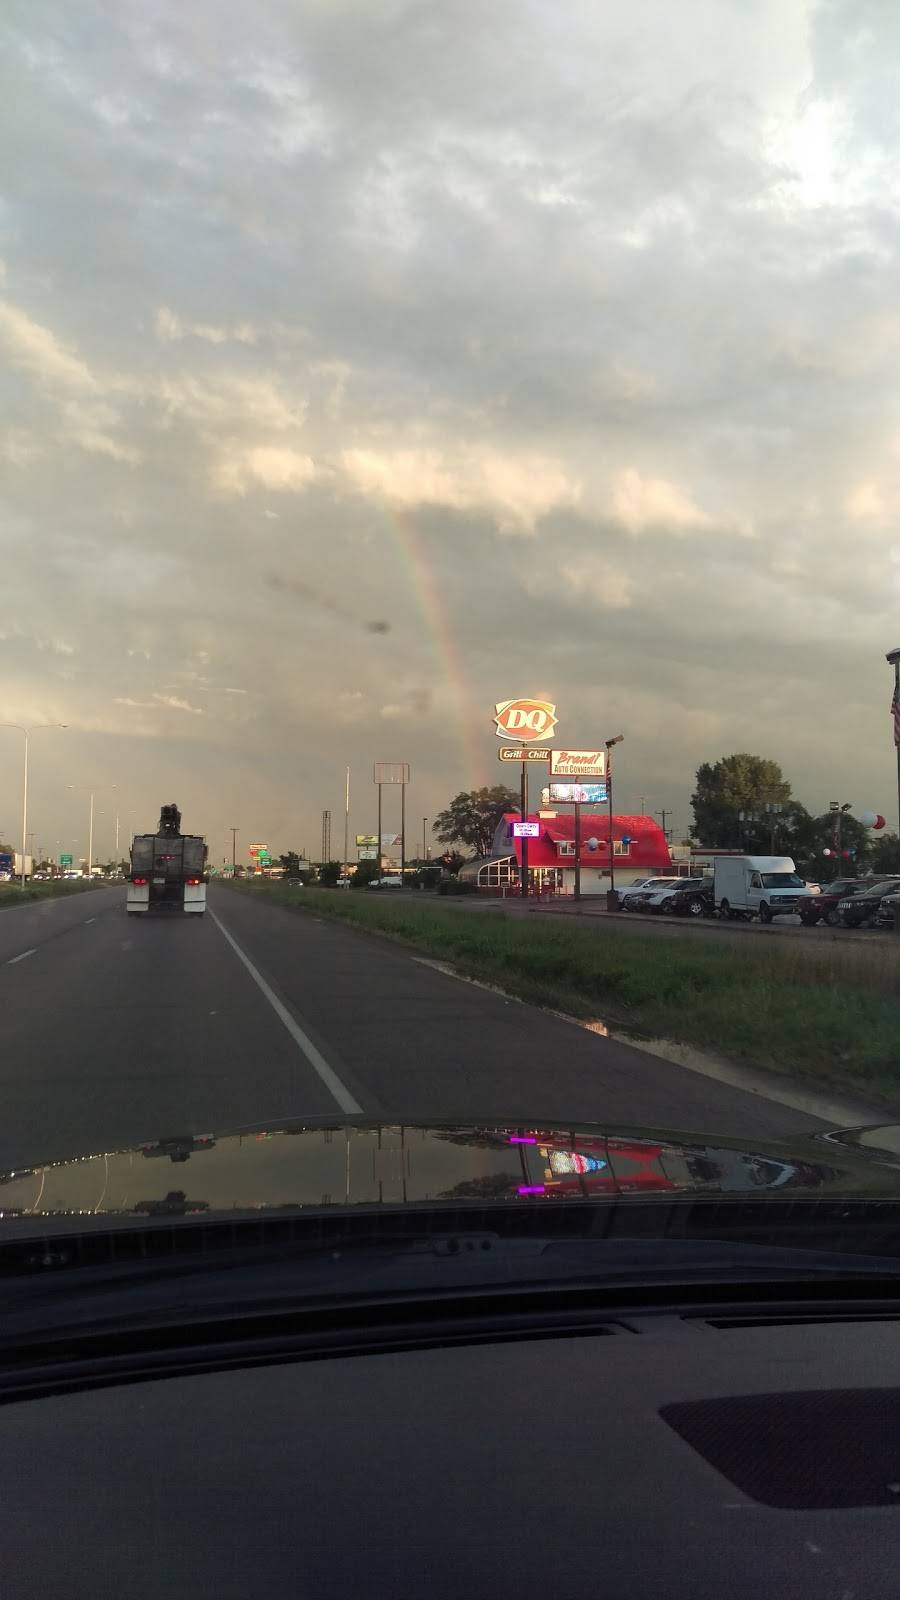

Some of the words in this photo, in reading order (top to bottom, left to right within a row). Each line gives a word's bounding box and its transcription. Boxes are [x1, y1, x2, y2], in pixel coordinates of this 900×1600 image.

[505, 709, 547, 733] DQ
[503, 750, 522, 758] Grill
[528, 750, 548, 759] Chill
